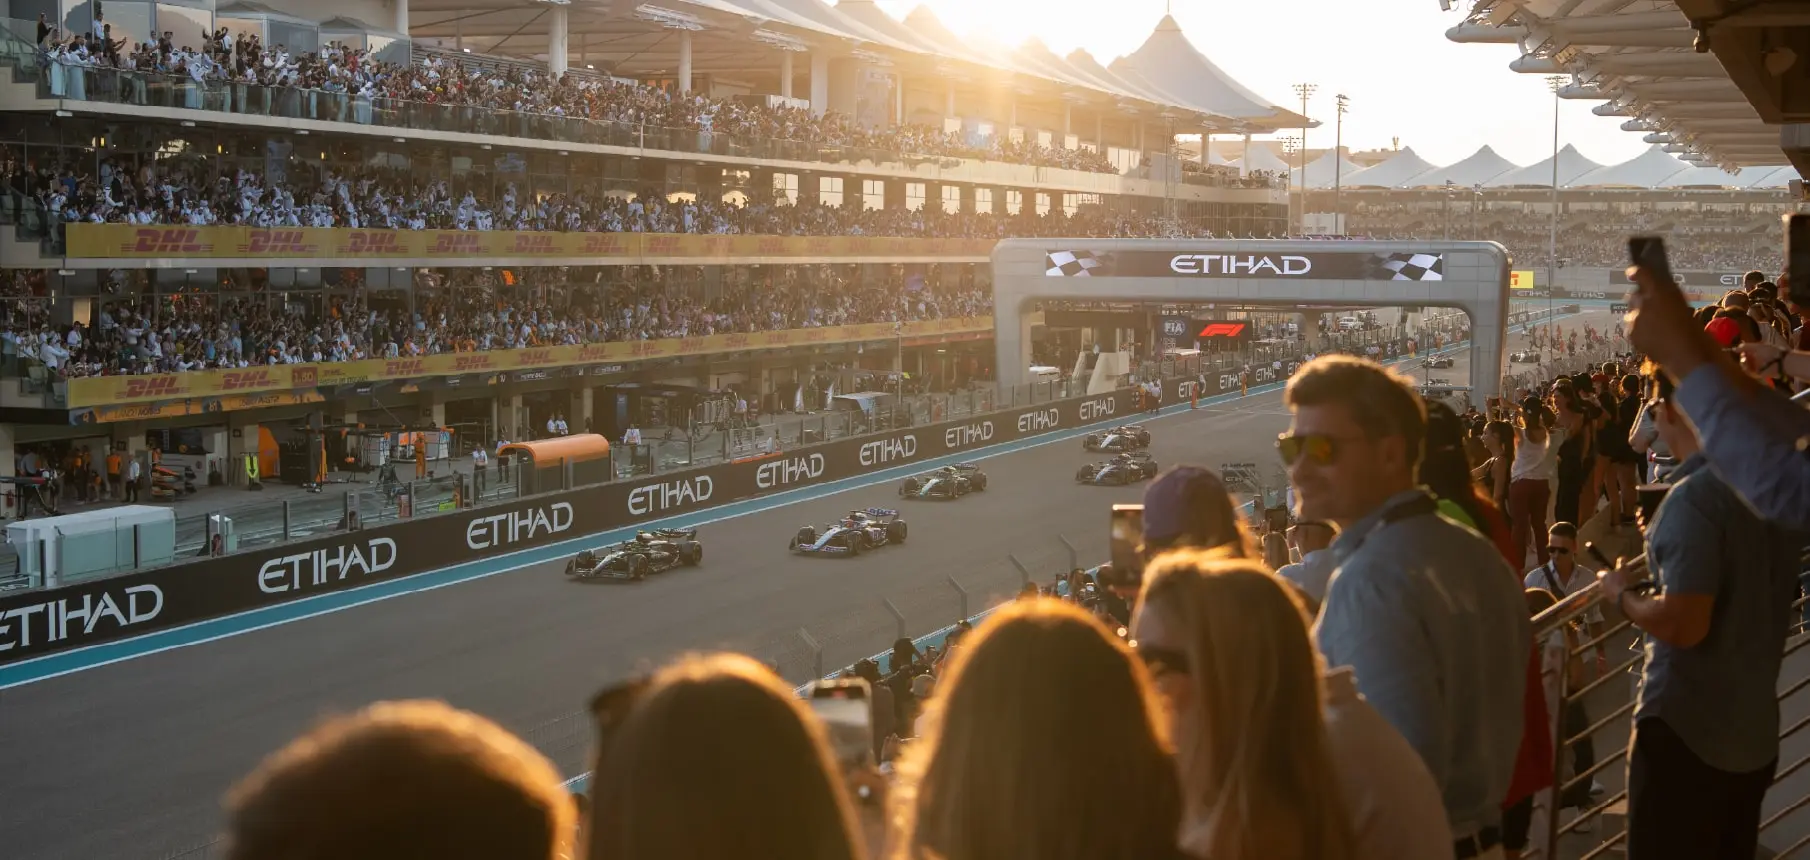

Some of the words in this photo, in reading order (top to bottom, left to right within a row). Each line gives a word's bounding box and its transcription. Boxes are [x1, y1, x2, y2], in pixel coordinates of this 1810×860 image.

[134, 229, 203, 252] DHL
[249, 231, 306, 252] DHL
[349, 232, 402, 252] DHL
[436, 234, 484, 253] DHL
[515, 235, 556, 253] DHL
[584, 236, 622, 253] DHL
[1170, 254, 1311, 275] ETIHAD
[1164, 322, 1183, 332] FIA
[1199, 323, 1246, 336] F1
[385, 359, 425, 376] DHL
[455, 355, 491, 371] DHL
[519, 351, 552, 365] DHL
[126, 375, 180, 398] DHL
[222, 370, 271, 390] DHL
[1079, 397, 1115, 420] ETIHAD
[1017, 408, 1059, 432] ETIHAD
[945, 421, 994, 448] ETIHAD
[859, 434, 917, 466] ETIHAD
[756, 453, 825, 489] ETIHAD
[627, 475, 713, 515] ETIHAD
[466, 502, 574, 549] ETIHAD
[257, 537, 397, 594] ETIHAD
